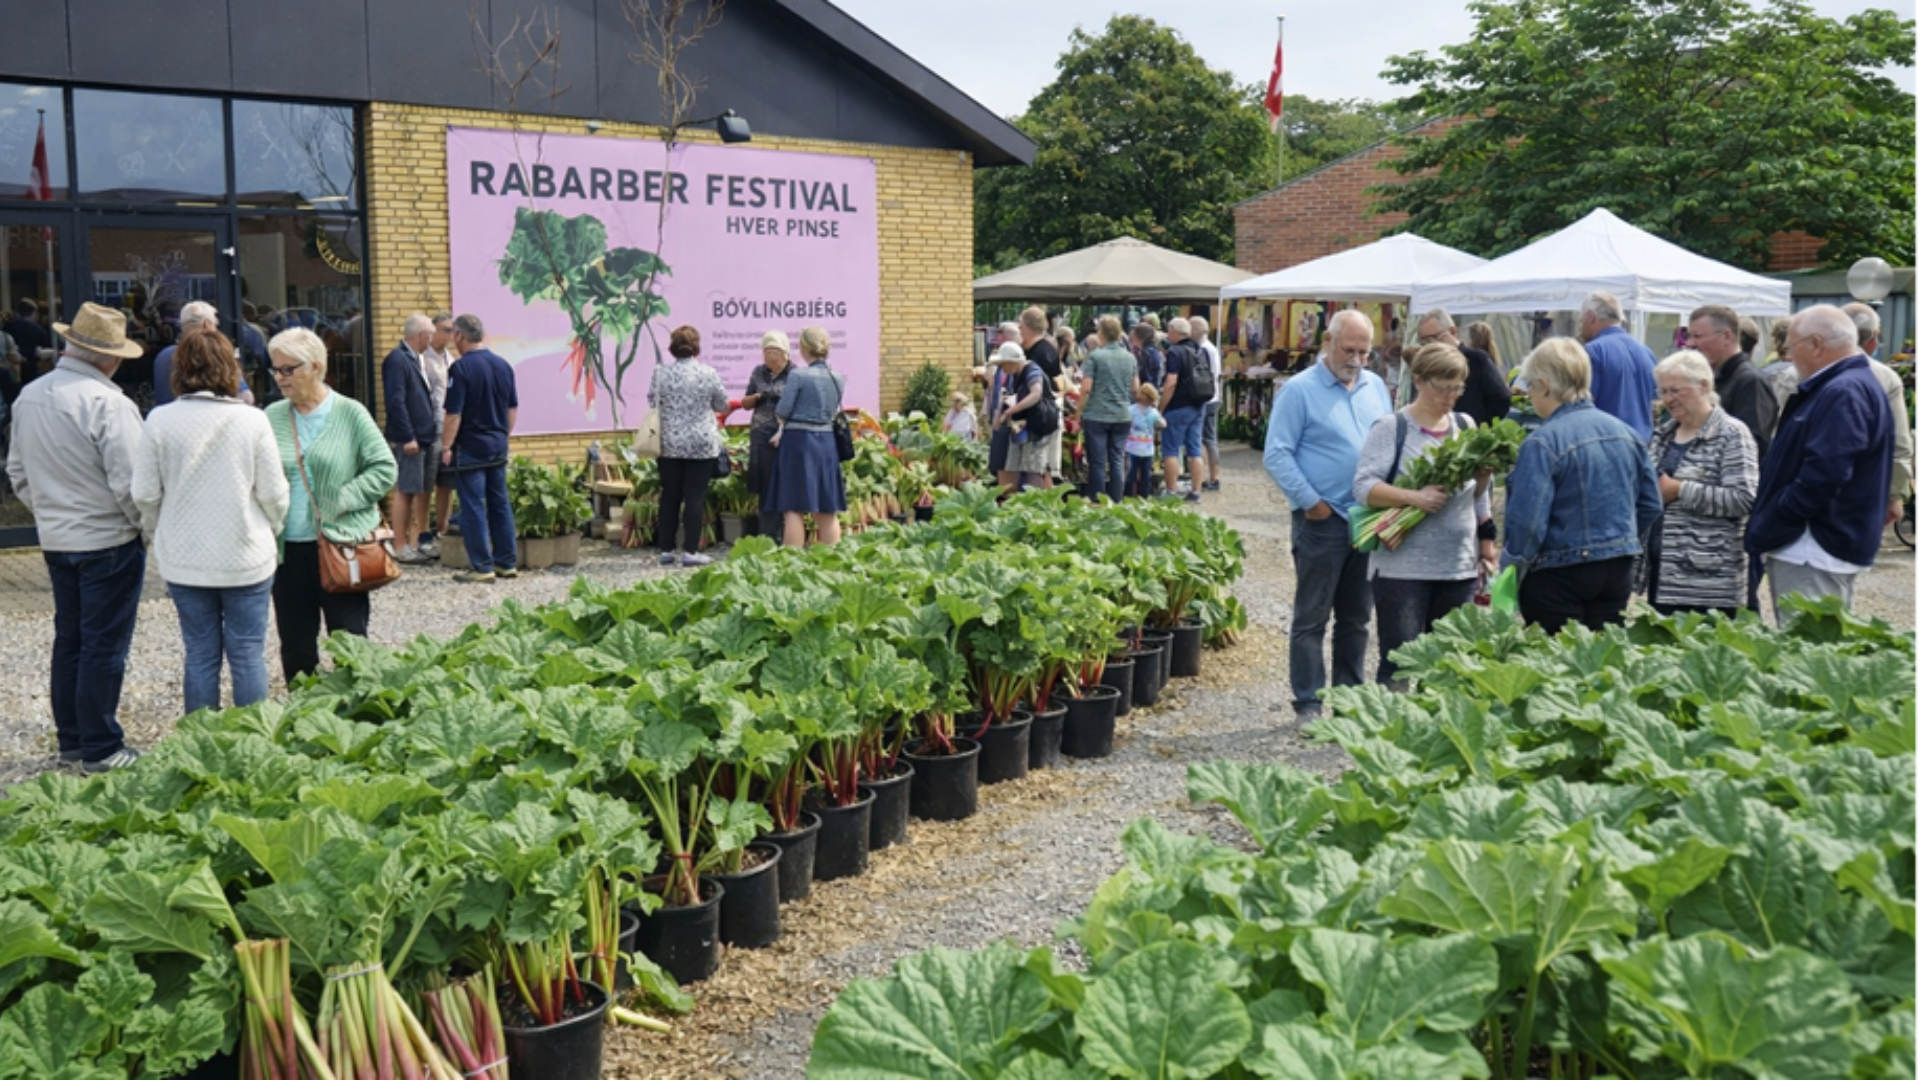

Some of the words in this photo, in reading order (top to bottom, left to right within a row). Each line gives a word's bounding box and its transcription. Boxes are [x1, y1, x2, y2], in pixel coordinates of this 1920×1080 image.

[470, 160, 689, 204] RABARBER
[706, 173, 858, 213] FESTIVAL
[726, 216, 779, 236] HVER
[786, 218, 839, 238] PINSE
